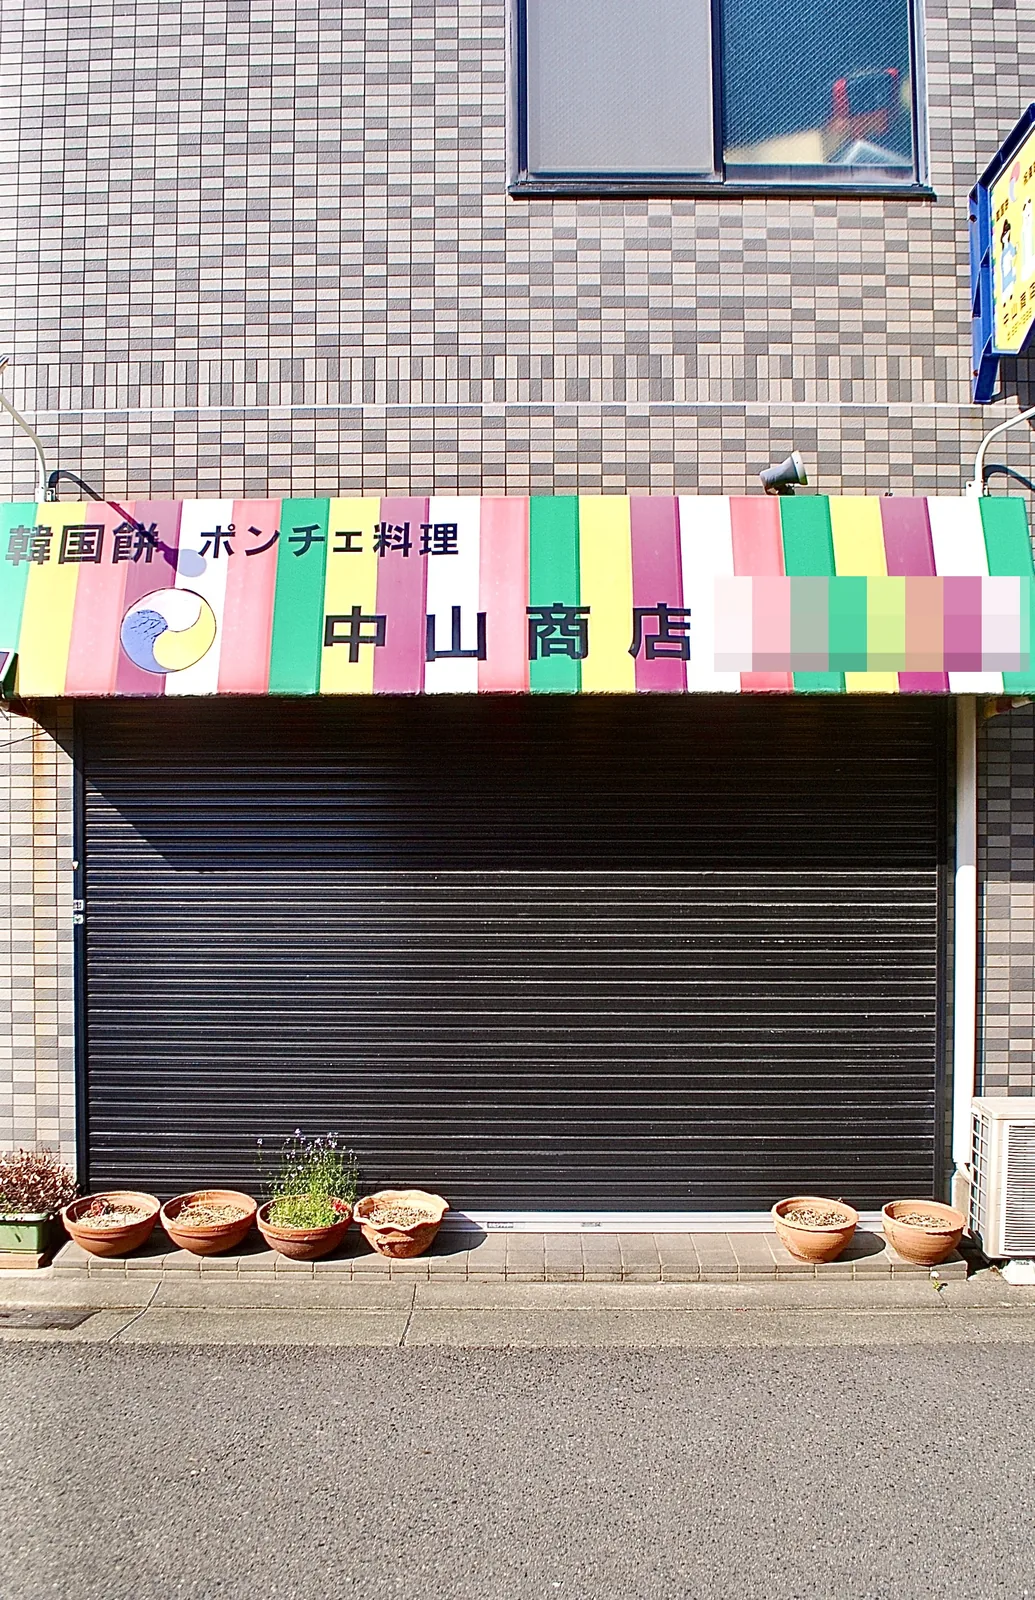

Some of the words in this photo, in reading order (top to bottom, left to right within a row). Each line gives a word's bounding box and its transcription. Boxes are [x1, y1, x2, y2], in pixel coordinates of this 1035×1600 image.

[5, 521, 160, 566] 韓国餅
[323, 602, 691, 663] 中山商店
